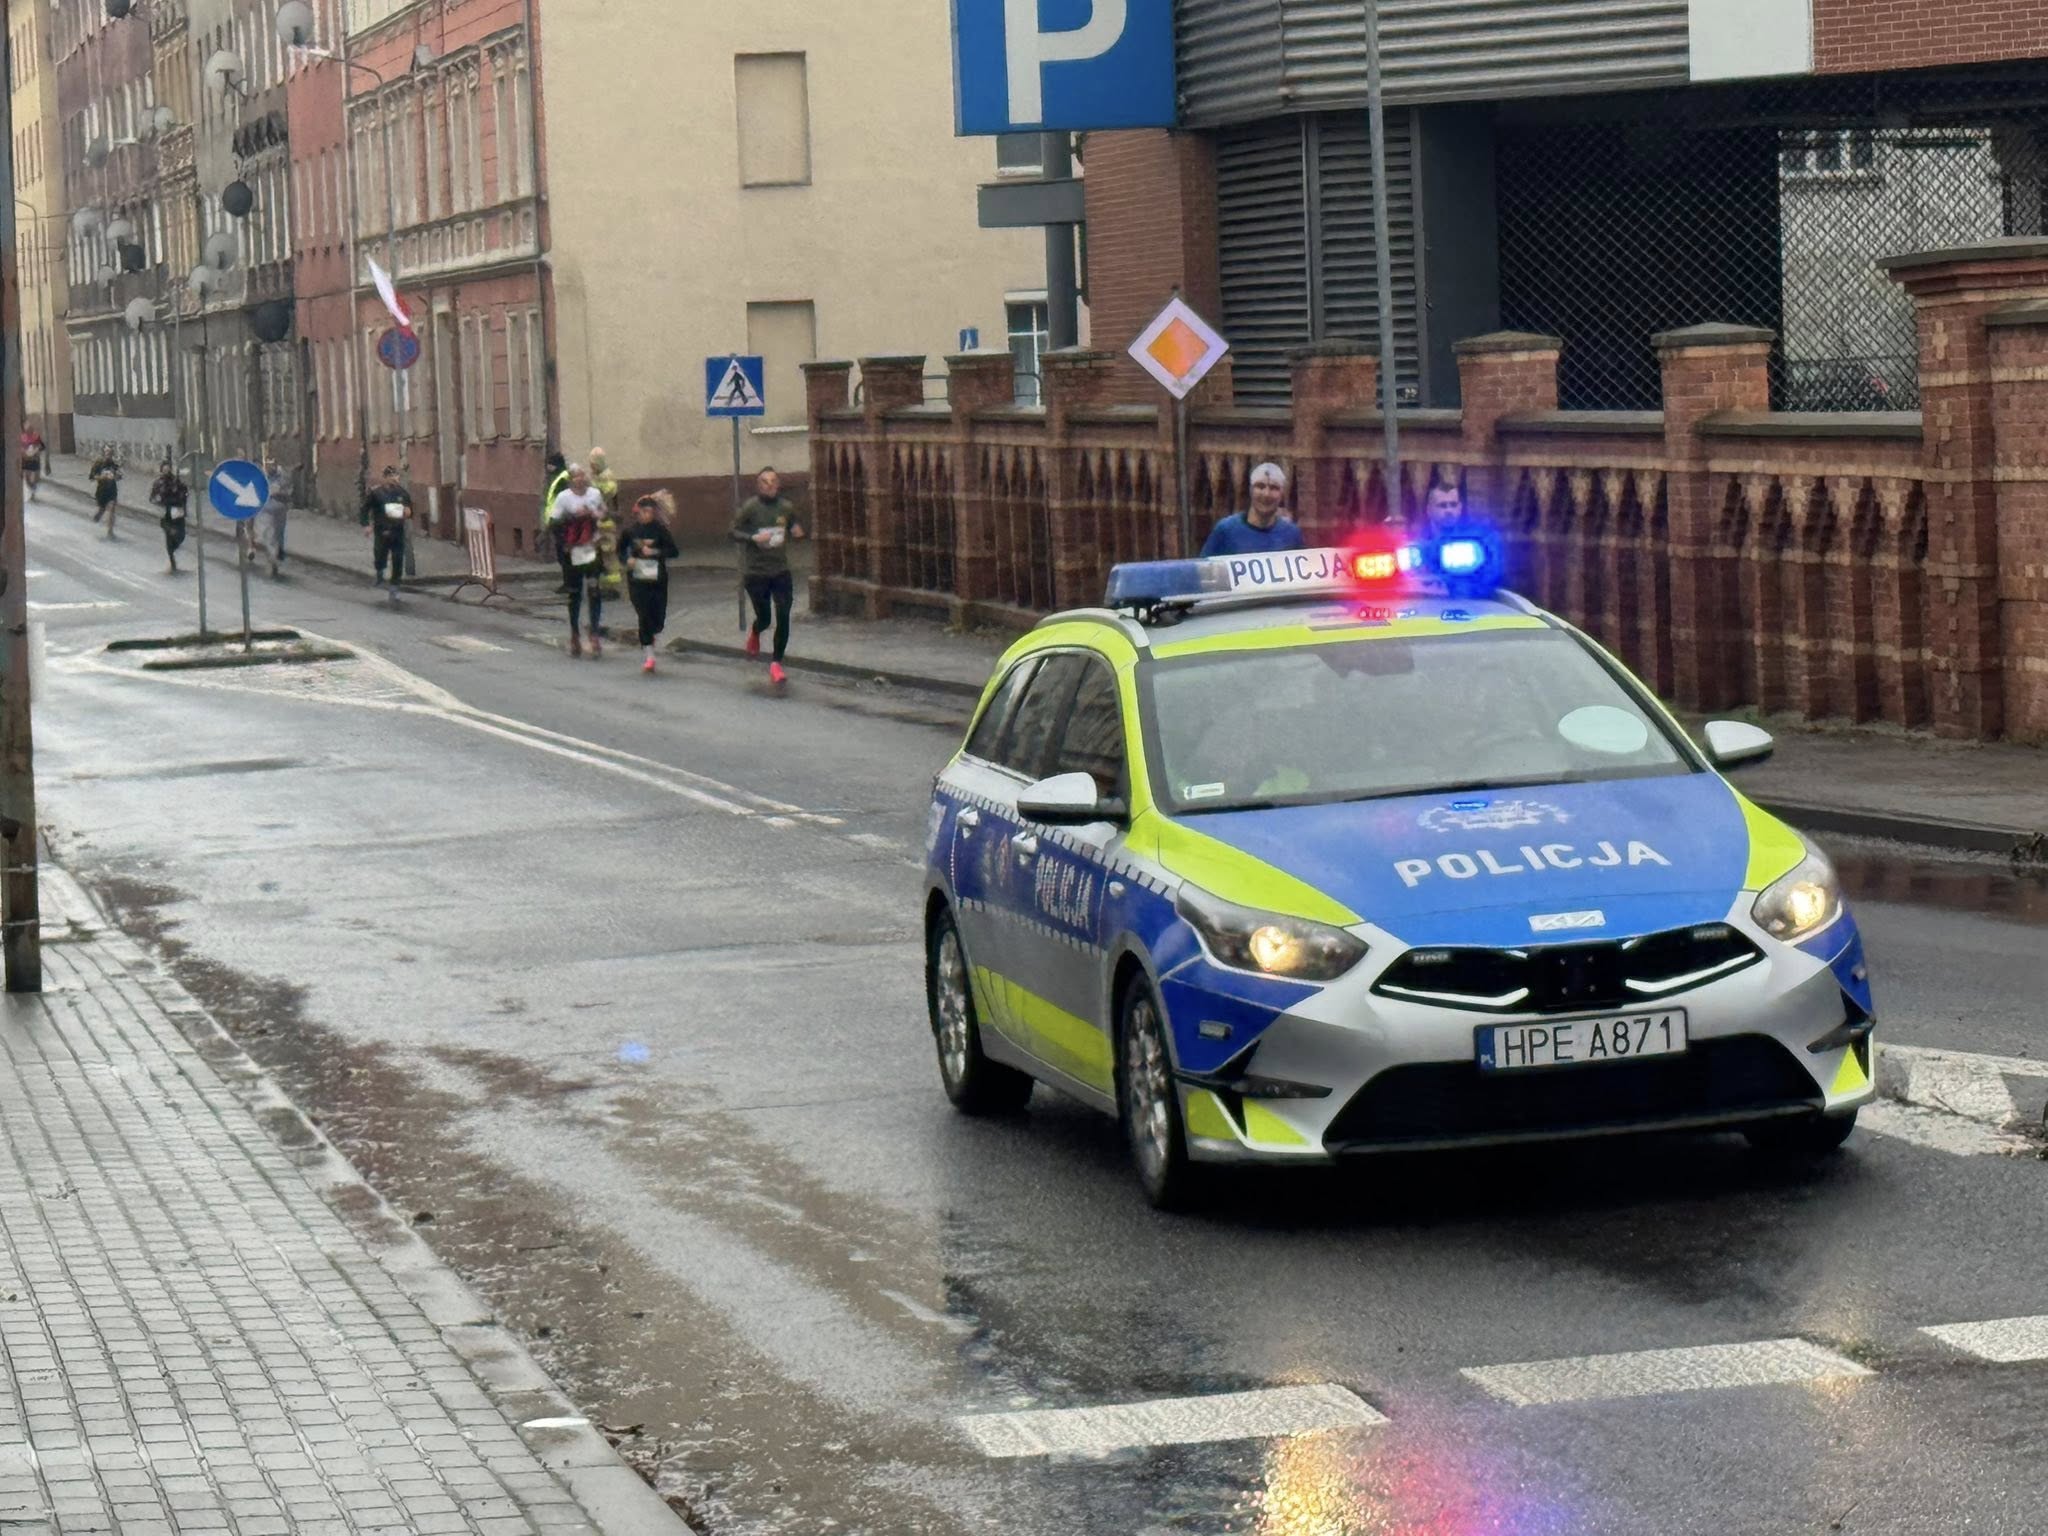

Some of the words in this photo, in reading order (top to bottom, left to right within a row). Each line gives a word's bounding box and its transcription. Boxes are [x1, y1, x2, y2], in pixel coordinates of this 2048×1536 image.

[1004, 0, 1127, 124] P
[1230, 552, 1353, 587] POLICJA
[1393, 841, 1672, 888] POLICJA
[1504, 1025, 1574, 1065] HPE
[1589, 1016, 1671, 1057] A871
